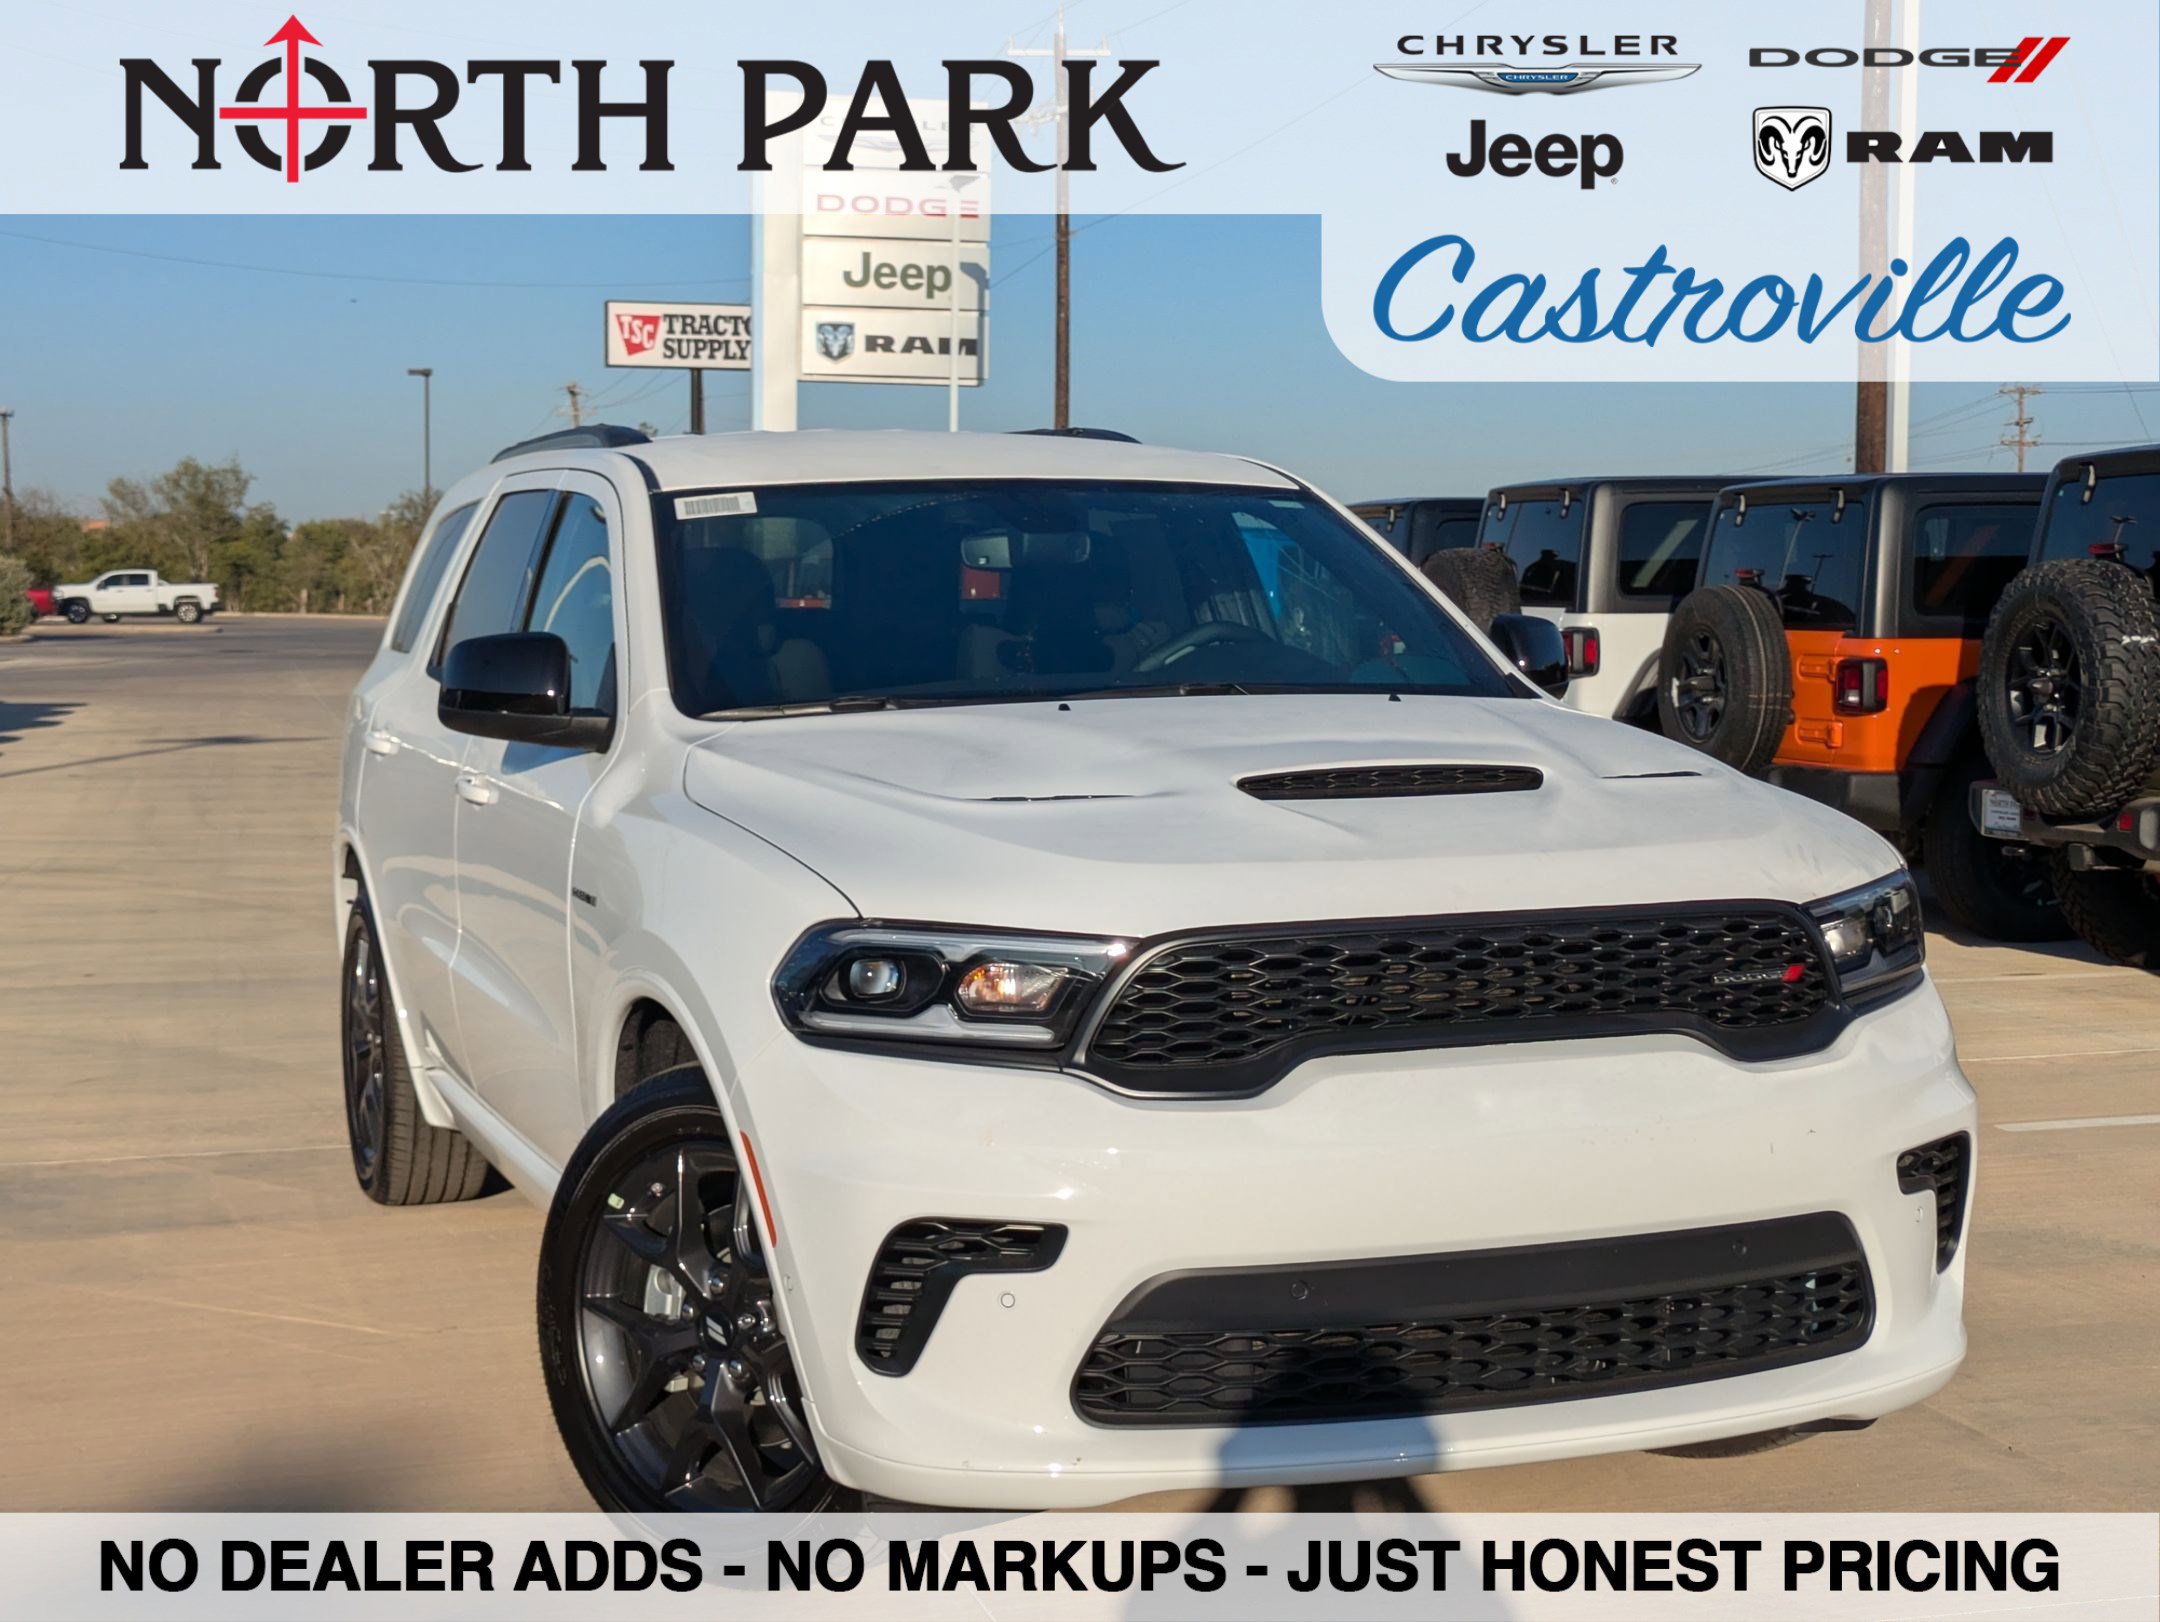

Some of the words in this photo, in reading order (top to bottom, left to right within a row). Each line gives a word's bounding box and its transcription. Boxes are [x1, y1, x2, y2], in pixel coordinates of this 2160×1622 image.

[817, 194, 979, 218] DODGE
[844, 252, 952, 299] Jeep
[620, 316, 654, 348] TSC
[663, 338, 752, 360] SUPPLY
[864, 334, 977, 356] RAM
